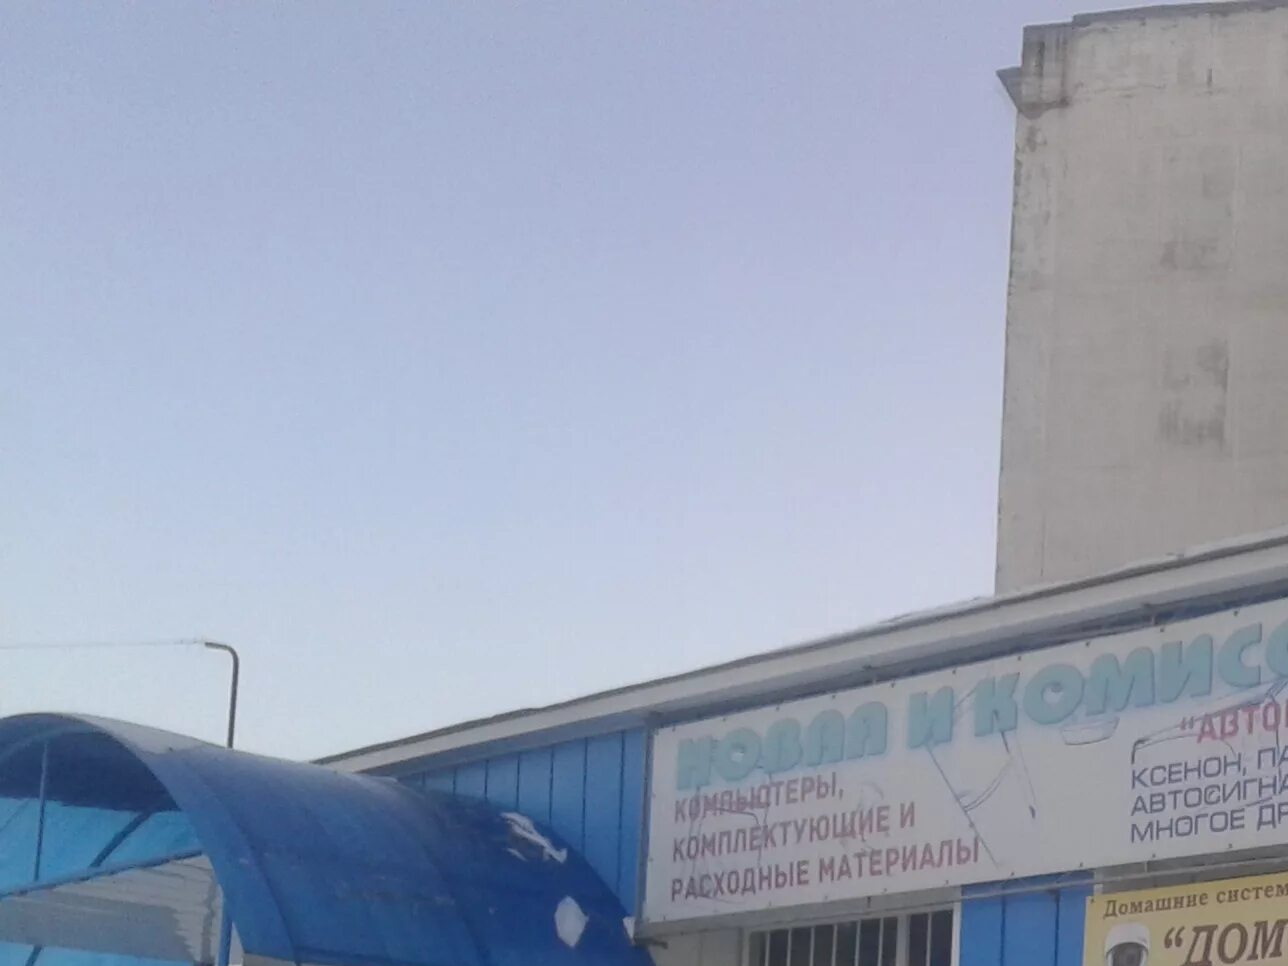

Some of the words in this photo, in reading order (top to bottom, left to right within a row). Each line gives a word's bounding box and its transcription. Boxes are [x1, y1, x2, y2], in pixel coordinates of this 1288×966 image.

[677, 701, 888, 791] НОВАЯ
[908, 686, 953, 749] И
[1131, 752, 1248, 788] КСЕНОН,
[674, 771, 844, 823] КОМПЬЮТЕРЫ,
[673, 805, 891, 862] КОМПЛЕКТУЮЩИЕ
[900, 802, 915, 829] И
[1131, 807, 1246, 844] МНОГОЕ
[671, 859, 809, 902] РАСХОДНЫЕ
[818, 836, 979, 883] МАТЕРИАЛЫ
[1103, 892, 1208, 919] Домашние
